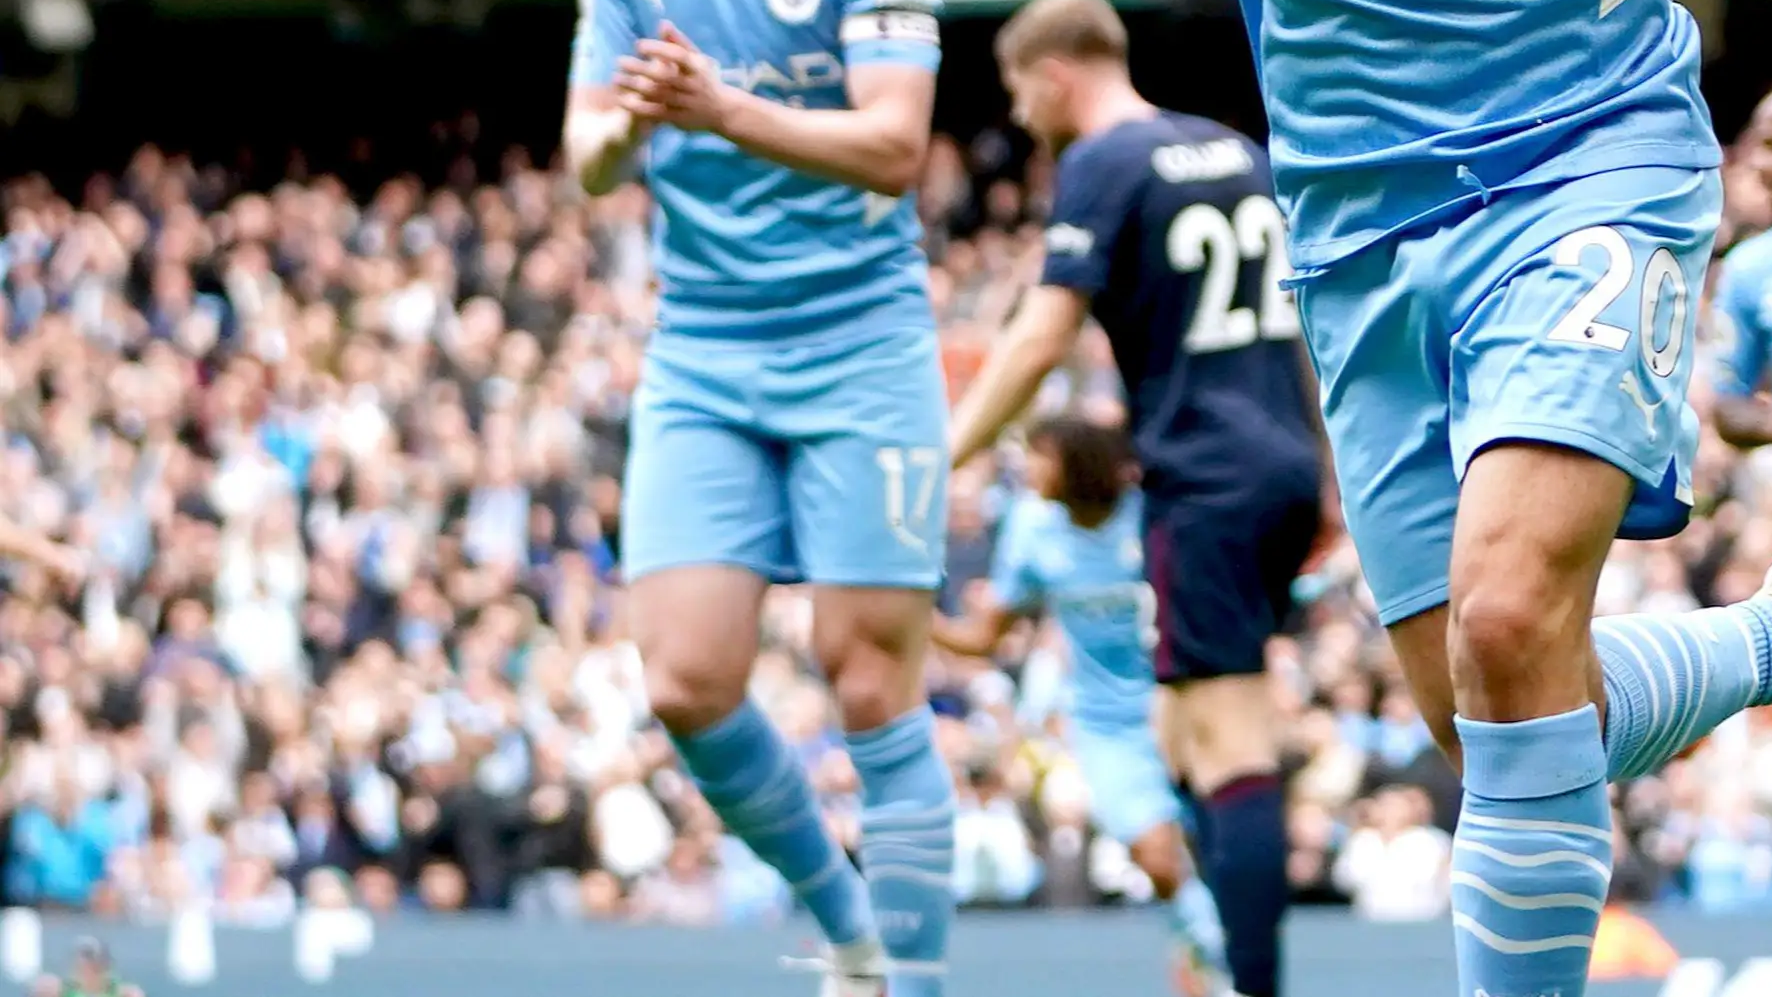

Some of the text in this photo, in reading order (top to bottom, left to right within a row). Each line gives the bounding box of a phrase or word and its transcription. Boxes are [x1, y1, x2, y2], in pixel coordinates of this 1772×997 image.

[1166, 194, 1300, 355] 22
[1547, 224, 1688, 379] 20
[875, 446, 942, 525] 17
